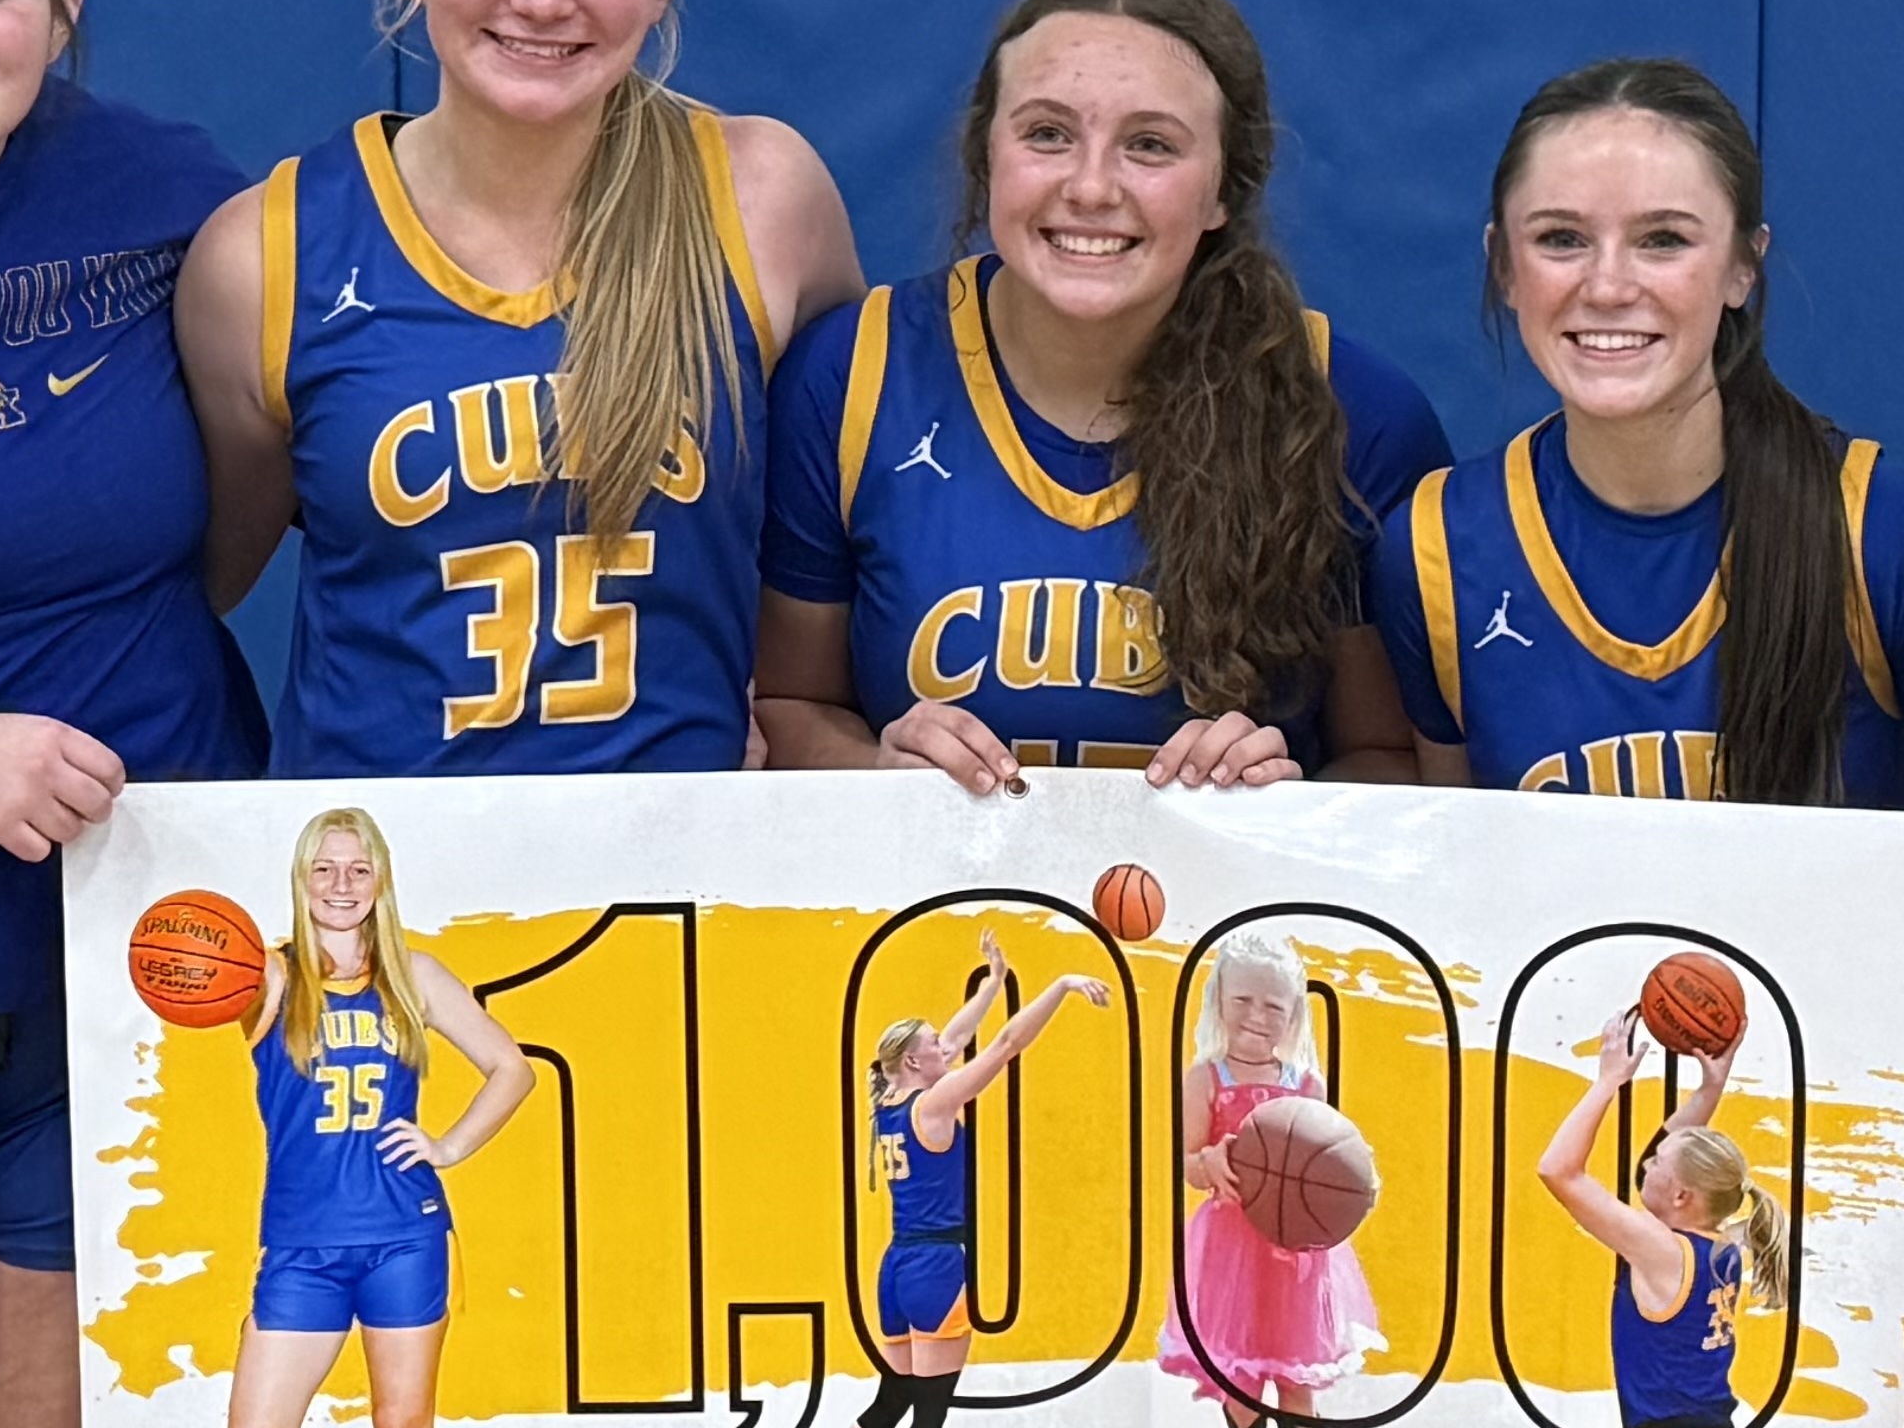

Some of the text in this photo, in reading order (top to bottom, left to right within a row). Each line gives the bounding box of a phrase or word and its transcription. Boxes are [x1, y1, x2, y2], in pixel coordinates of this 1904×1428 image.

[439, 529, 656, 740] 35
[906, 576, 1172, 704] CUB
[315, 1062, 388, 1134] 35
